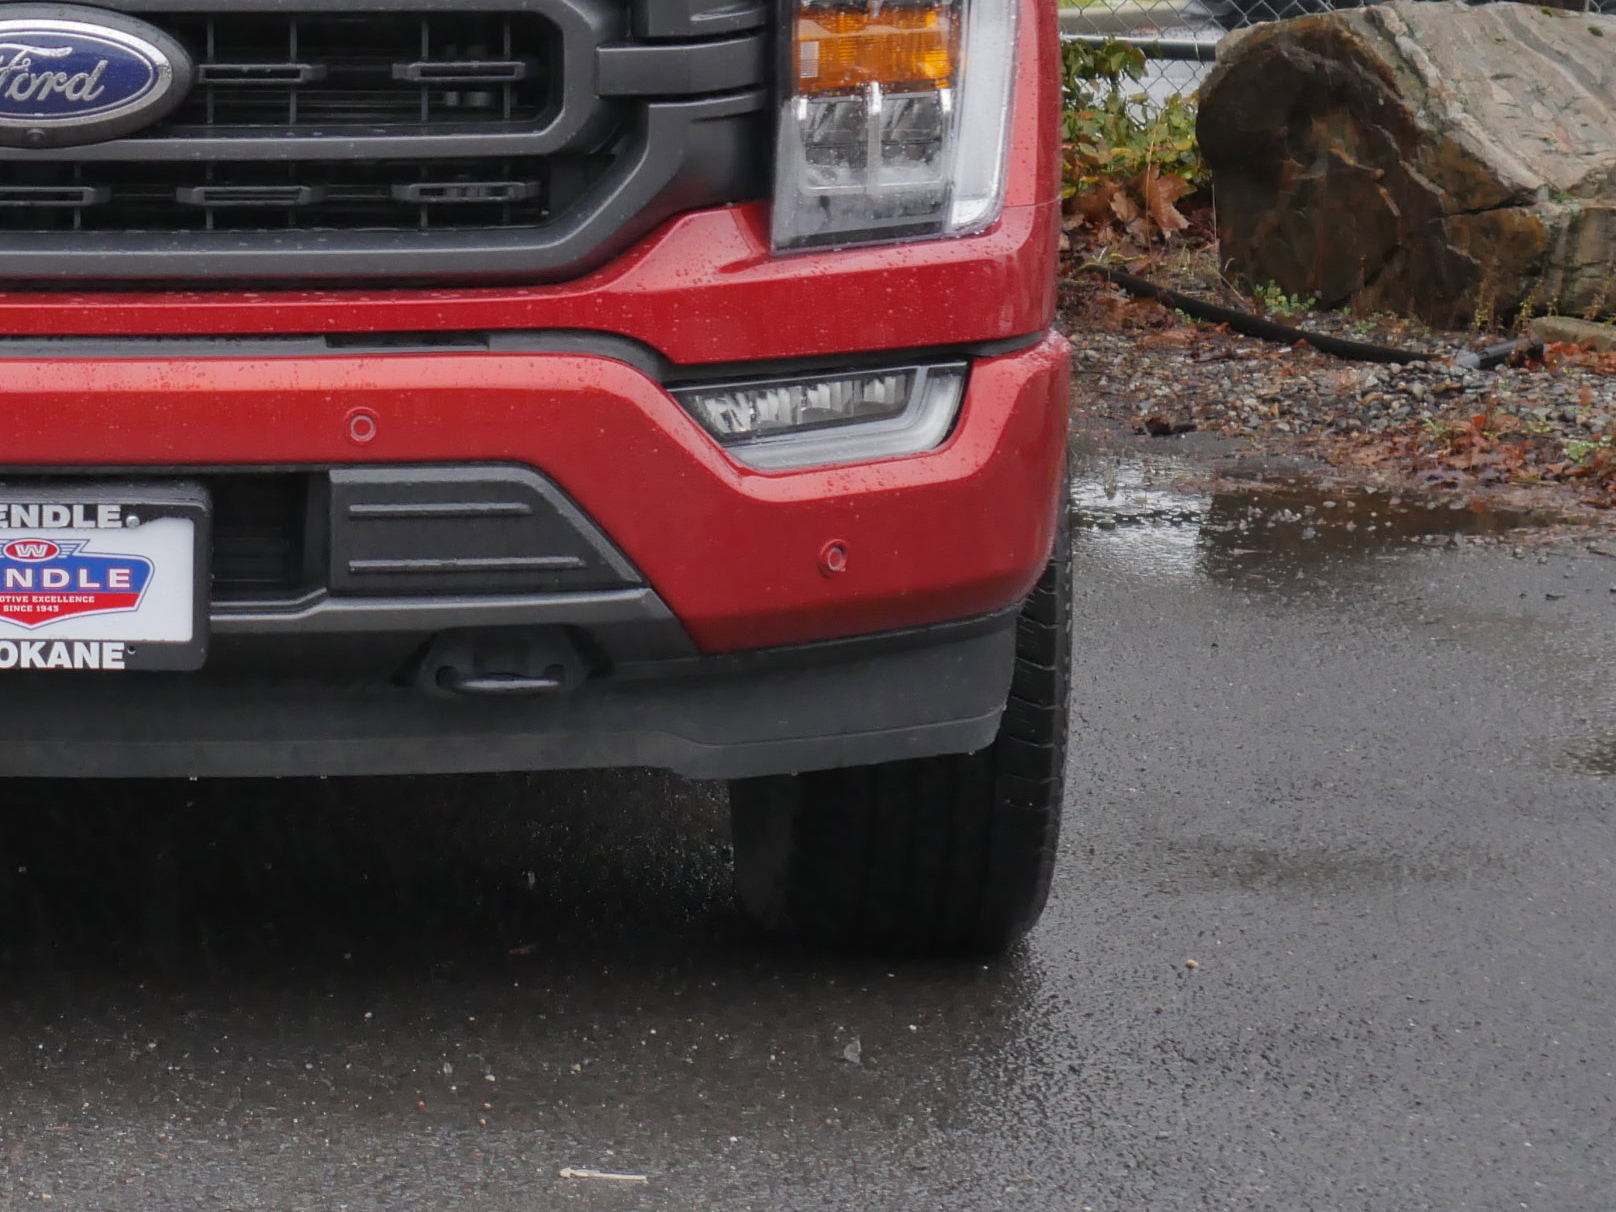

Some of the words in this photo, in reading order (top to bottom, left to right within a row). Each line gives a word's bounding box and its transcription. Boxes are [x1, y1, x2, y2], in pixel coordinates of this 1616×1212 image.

[32, 595, 95, 603] EXCELLENCE
[3, 605, 33, 613] SINCE
[36, 605, 59, 613] 1943
